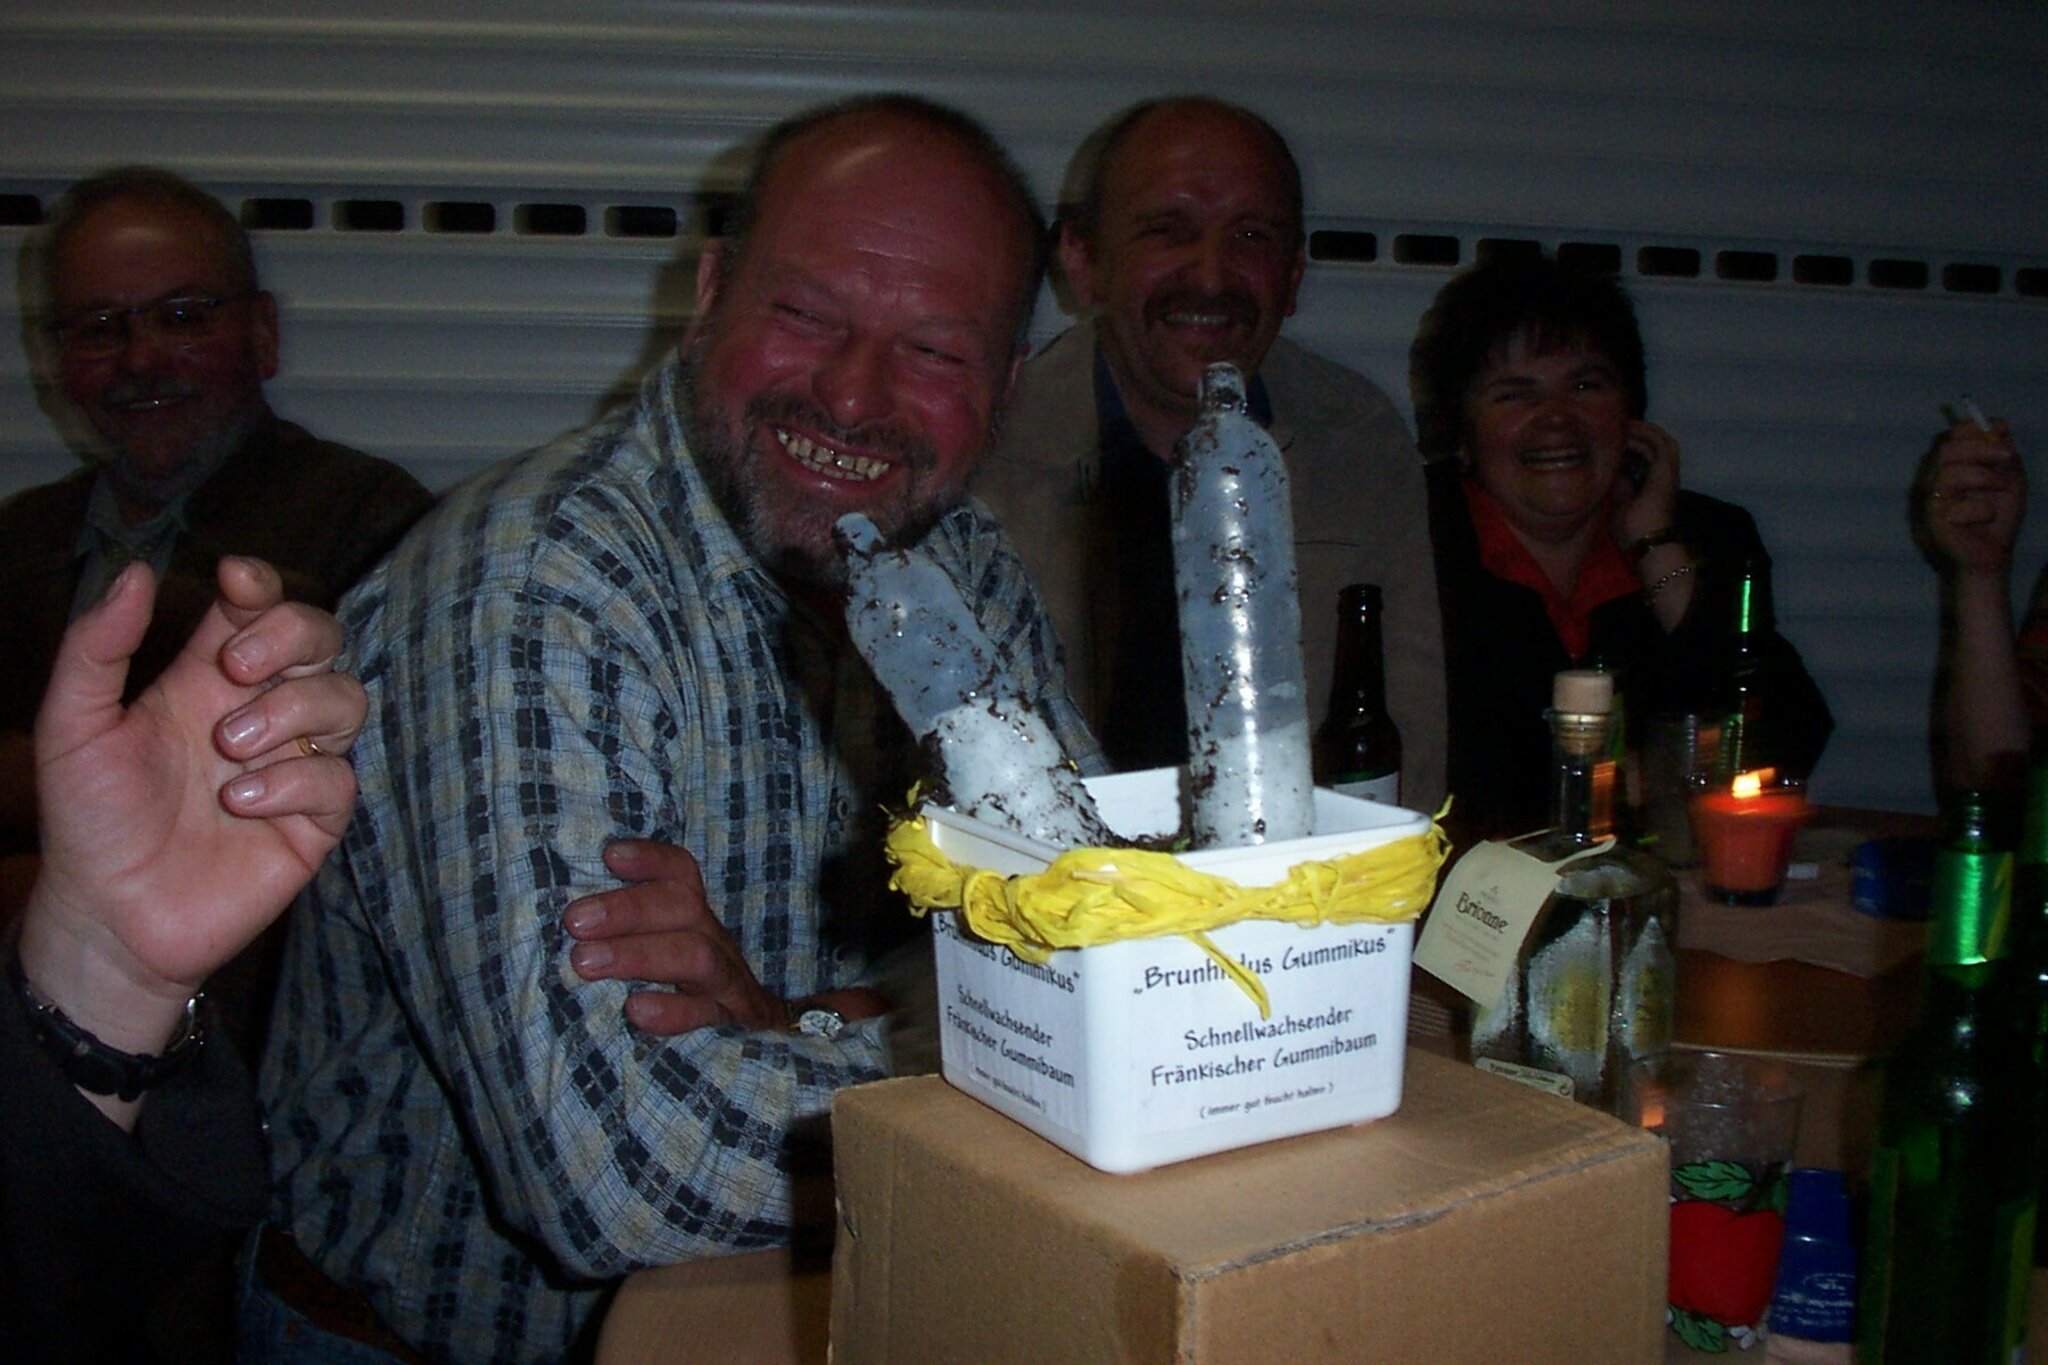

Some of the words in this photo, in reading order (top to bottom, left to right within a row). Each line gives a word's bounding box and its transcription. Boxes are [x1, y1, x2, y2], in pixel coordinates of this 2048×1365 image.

[1184, 1007, 1353, 1051] Schnellwachsender
[1001, 1039, 1075, 1088] Gummibaum
[1151, 1055, 1266, 1087] Fränkischer
[1273, 1032, 1378, 1068] Gummibaum
